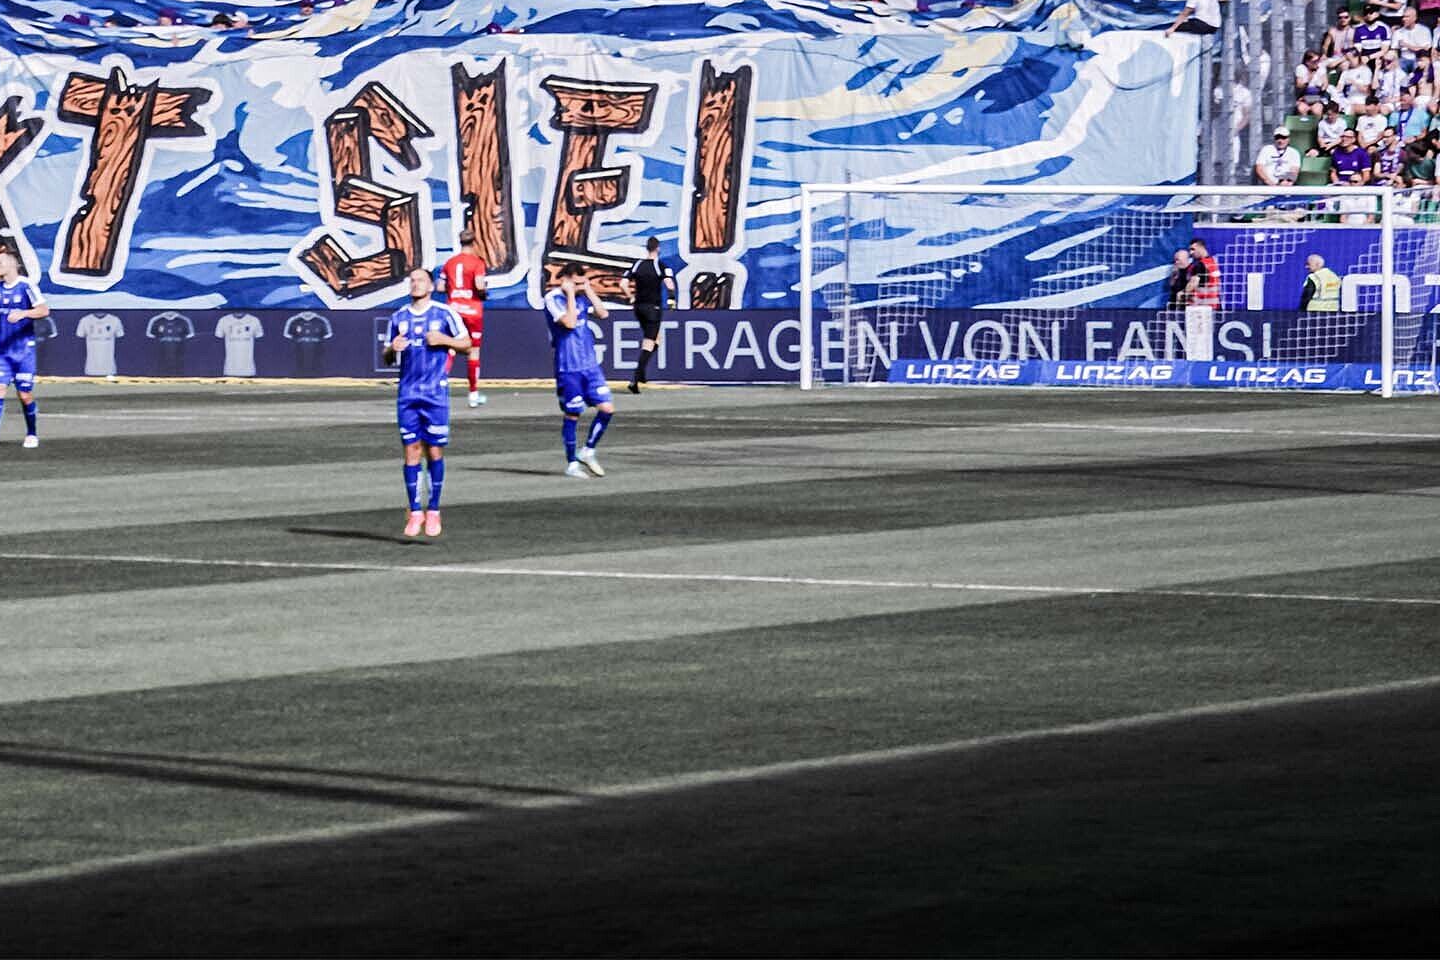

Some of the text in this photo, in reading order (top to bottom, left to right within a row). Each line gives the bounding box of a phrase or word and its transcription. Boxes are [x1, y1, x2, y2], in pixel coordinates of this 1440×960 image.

[298, 56, 752, 308] SIE!
[919, 321, 1061, 360] VON
[906, 364, 1020, 380] LINZ AG
[1056, 365, 1172, 381] LINZ AG
[1208, 366, 1327, 384] LINZ AG
[1364, 369, 1434, 385] LNZ
